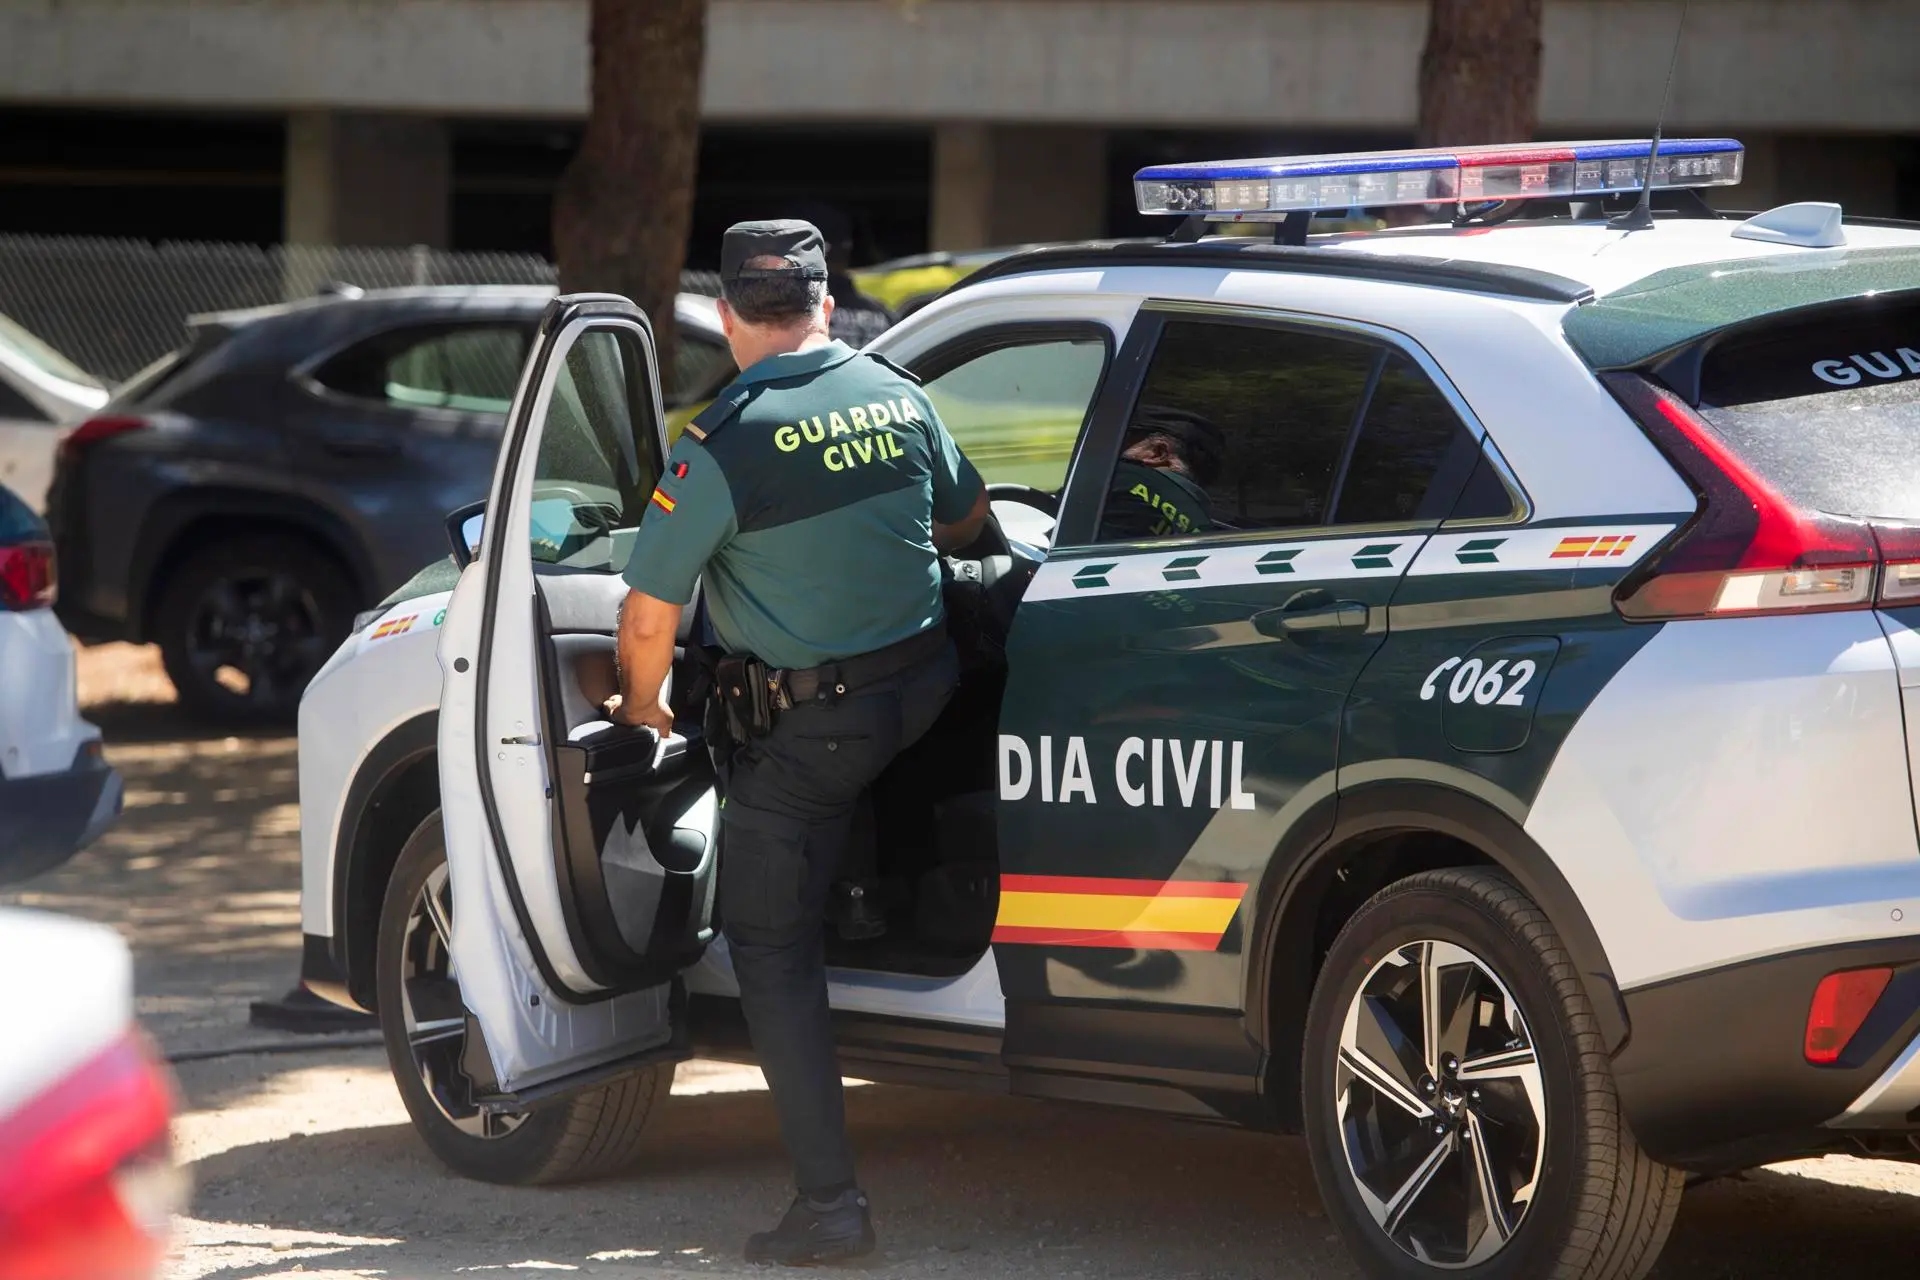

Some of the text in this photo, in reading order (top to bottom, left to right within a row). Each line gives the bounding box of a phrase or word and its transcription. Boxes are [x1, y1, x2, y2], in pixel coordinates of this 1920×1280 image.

[774, 398, 921, 452] GUARDIA
[823, 432, 904, 472] CIVIL
[1448, 658, 1536, 706] 062
[998, 734, 1256, 810] DIA CIVIL
